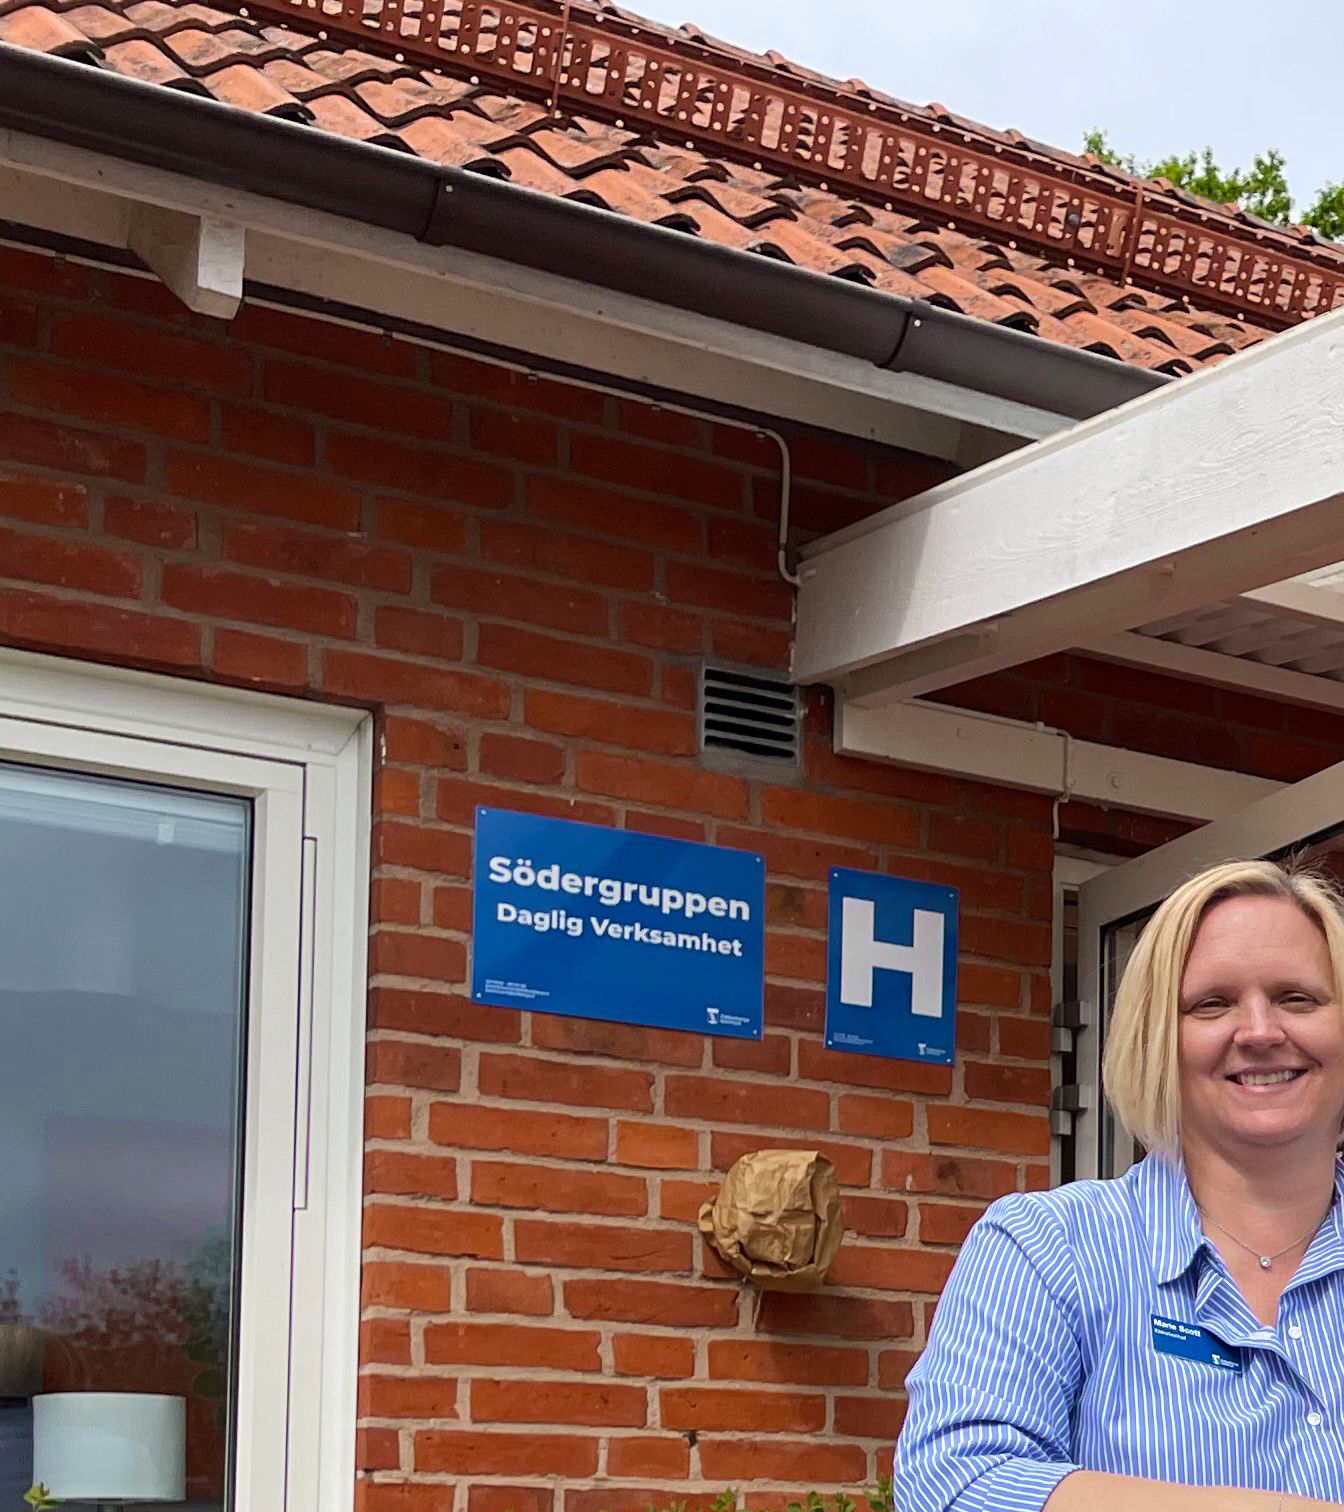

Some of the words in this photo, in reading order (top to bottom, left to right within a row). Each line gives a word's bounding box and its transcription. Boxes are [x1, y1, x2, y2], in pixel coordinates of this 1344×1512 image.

[489, 856, 750, 921] Södergruppen
[496, 902, 583, 936] Daglig
[590, 916, 743, 957] Verksamhet
[840, 896, 945, 1018] H
